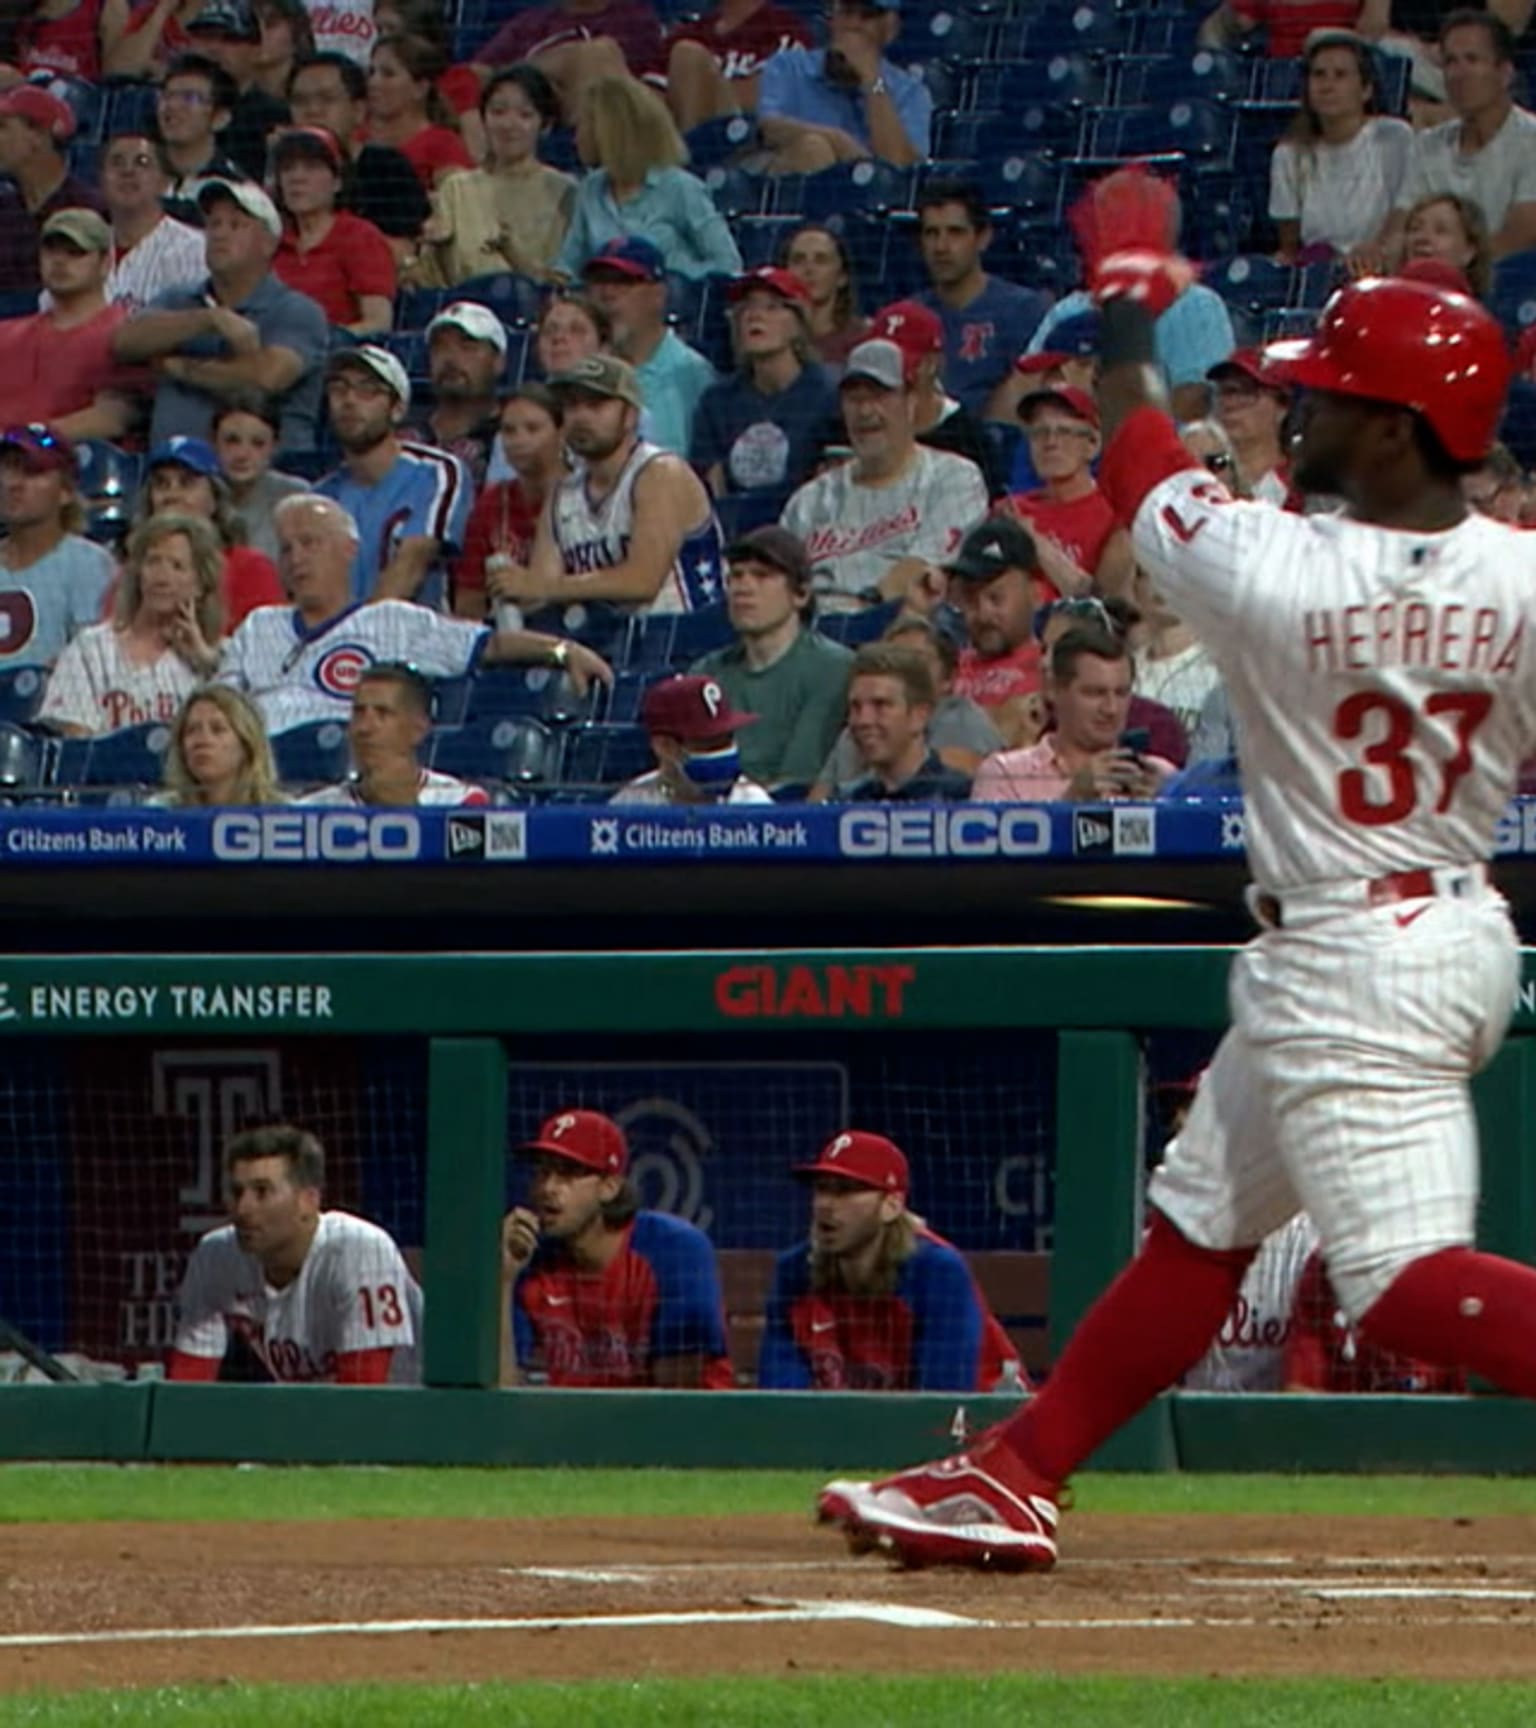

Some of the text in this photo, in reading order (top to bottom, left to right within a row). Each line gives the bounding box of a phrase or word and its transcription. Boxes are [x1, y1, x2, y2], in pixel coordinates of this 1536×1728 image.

[1331, 688, 1494, 828] 37
[7, 826, 187, 852] Citizens Bank Park
[212, 813, 421, 861] GEICO
[625, 821, 808, 849] Citizens Bank Park
[839, 810, 1052, 857] GEICO
[30, 986, 334, 1018] ENERGY TRANSFER
[715, 966, 916, 1018] GIANT
[358, 1283, 404, 1331] 13
